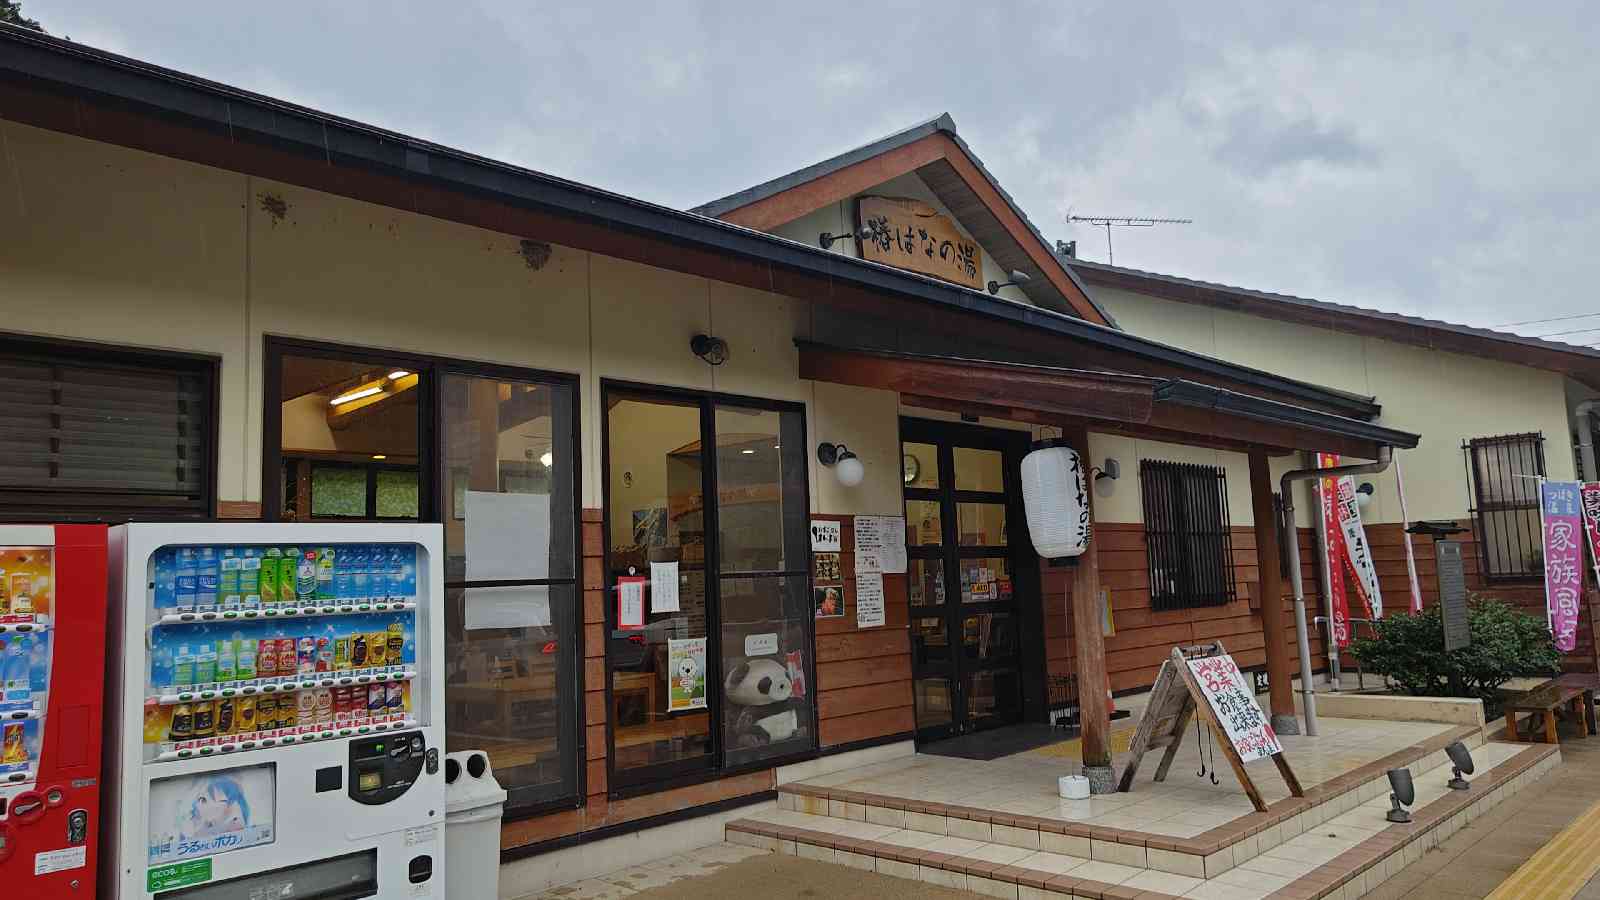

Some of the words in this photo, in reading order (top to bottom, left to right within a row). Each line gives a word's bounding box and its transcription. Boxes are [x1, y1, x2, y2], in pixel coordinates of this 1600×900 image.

[868, 215, 977, 279] 椿はなの湯
